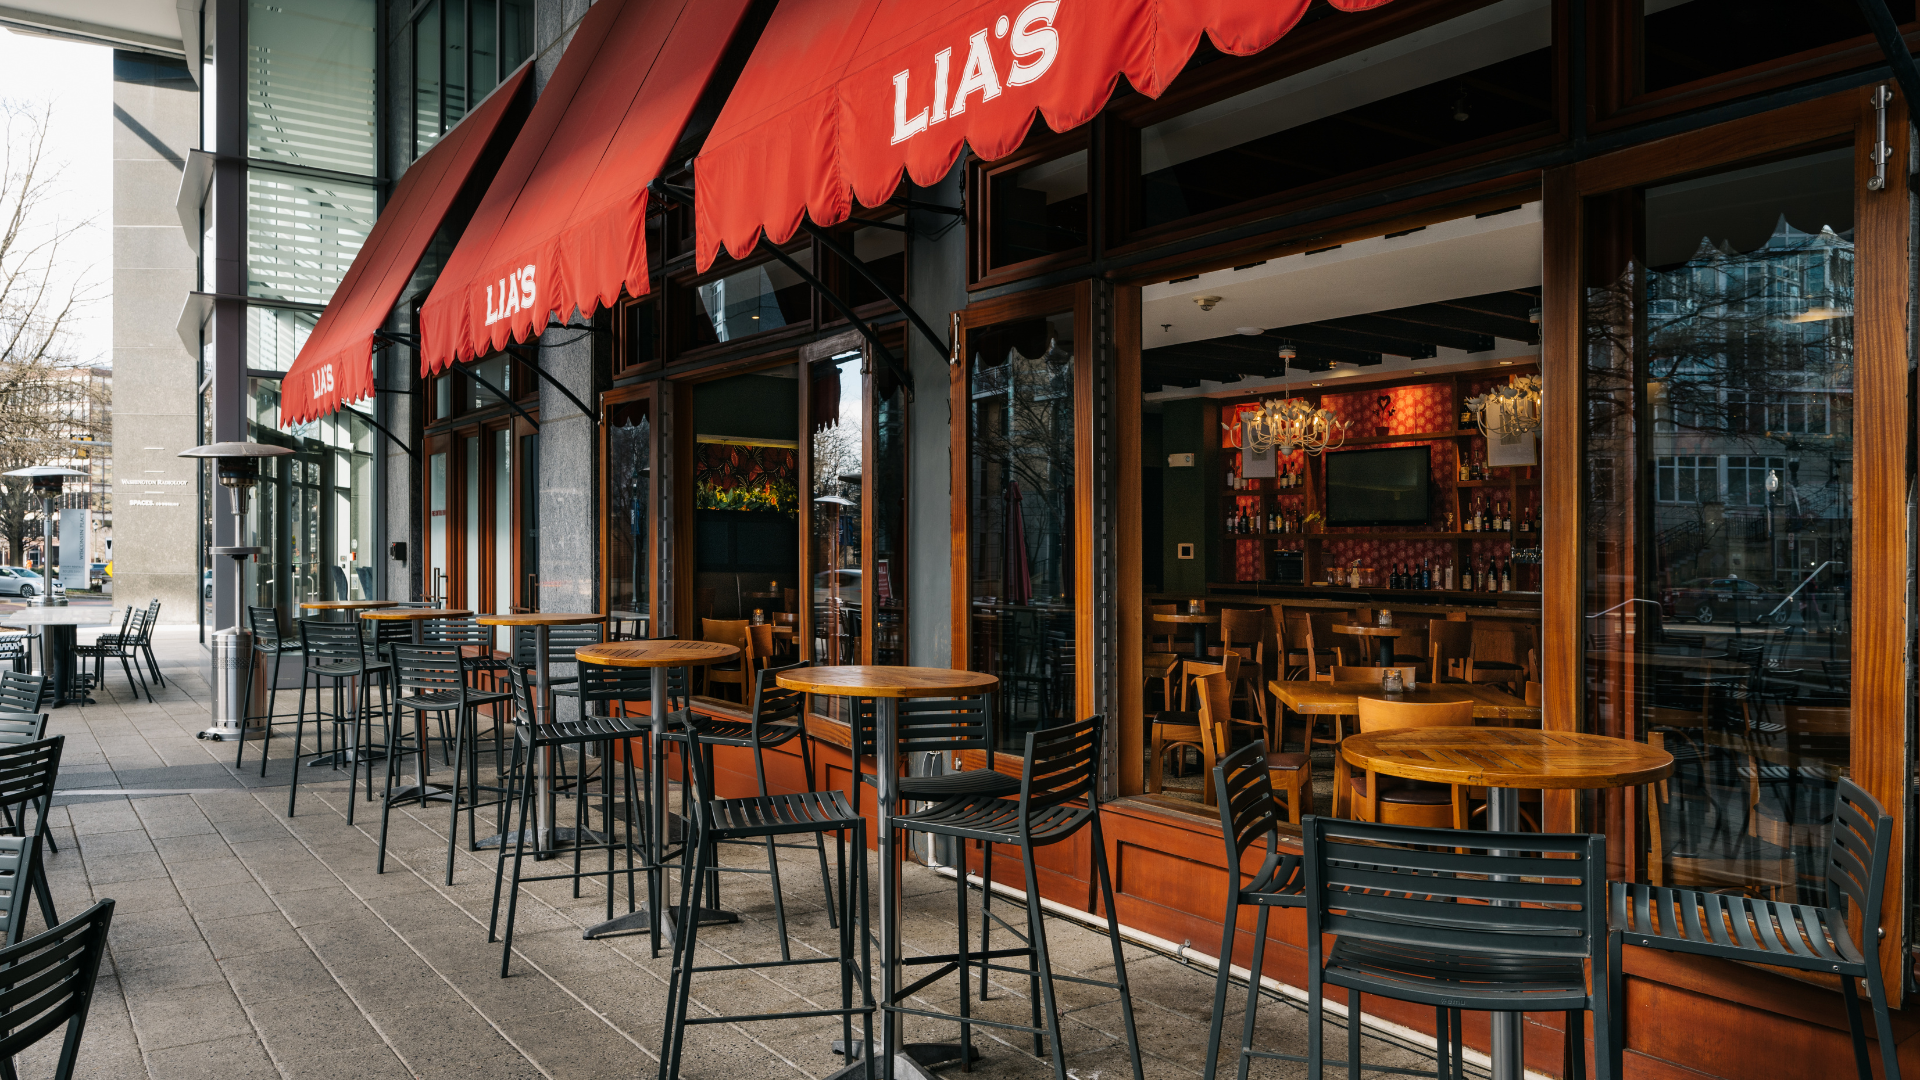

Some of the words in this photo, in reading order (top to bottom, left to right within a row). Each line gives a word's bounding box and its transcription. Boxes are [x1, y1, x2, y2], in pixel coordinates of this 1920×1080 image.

[891, 0, 1061, 146] LIA'S
[485, 264, 536, 327] LIA'S
[311, 363, 334, 400] LIA'S
